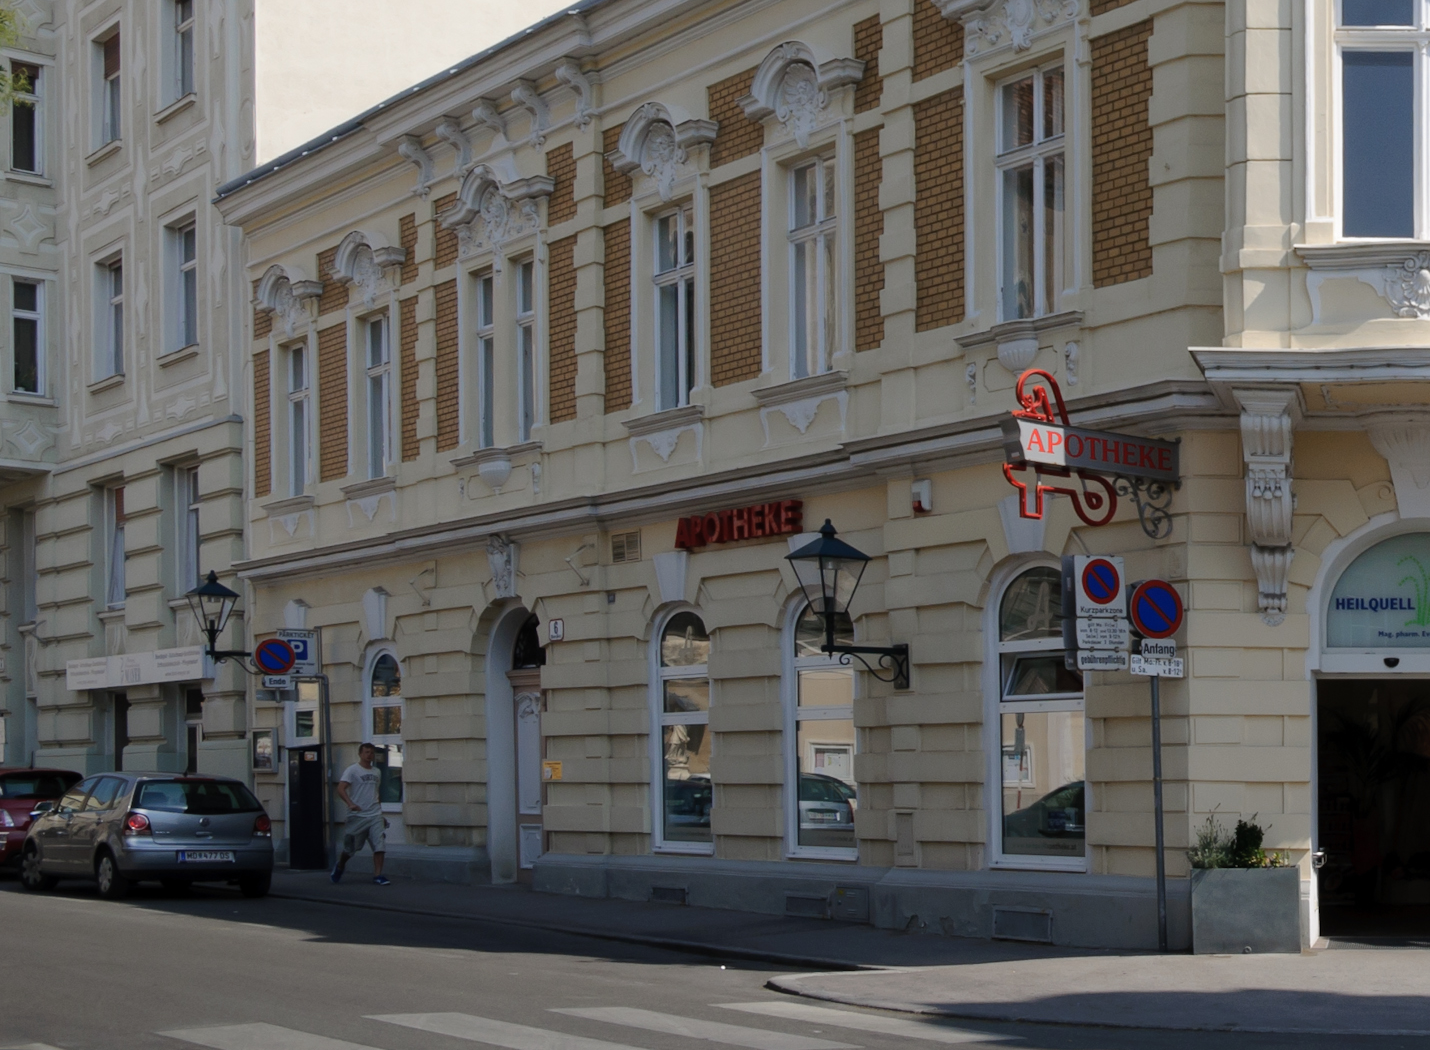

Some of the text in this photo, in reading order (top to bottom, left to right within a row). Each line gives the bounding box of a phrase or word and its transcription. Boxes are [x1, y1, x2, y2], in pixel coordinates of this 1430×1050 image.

[1027, 428, 1173, 472] APOTHEKE
[675, 499, 803, 548] APOTHEKE
[1335, 597, 1416, 612] HEILQUELL
[1080, 606, 1123, 615] Kurzparkzone
[1378, 631, 1394, 639] Mag.
[1143, 643, 1175, 658] Anfang
[1081, 655, 1126, 666] gebührenpflichtig
[1131, 656, 1142, 664] Gilt
[268, 677, 287, 685] Ende
